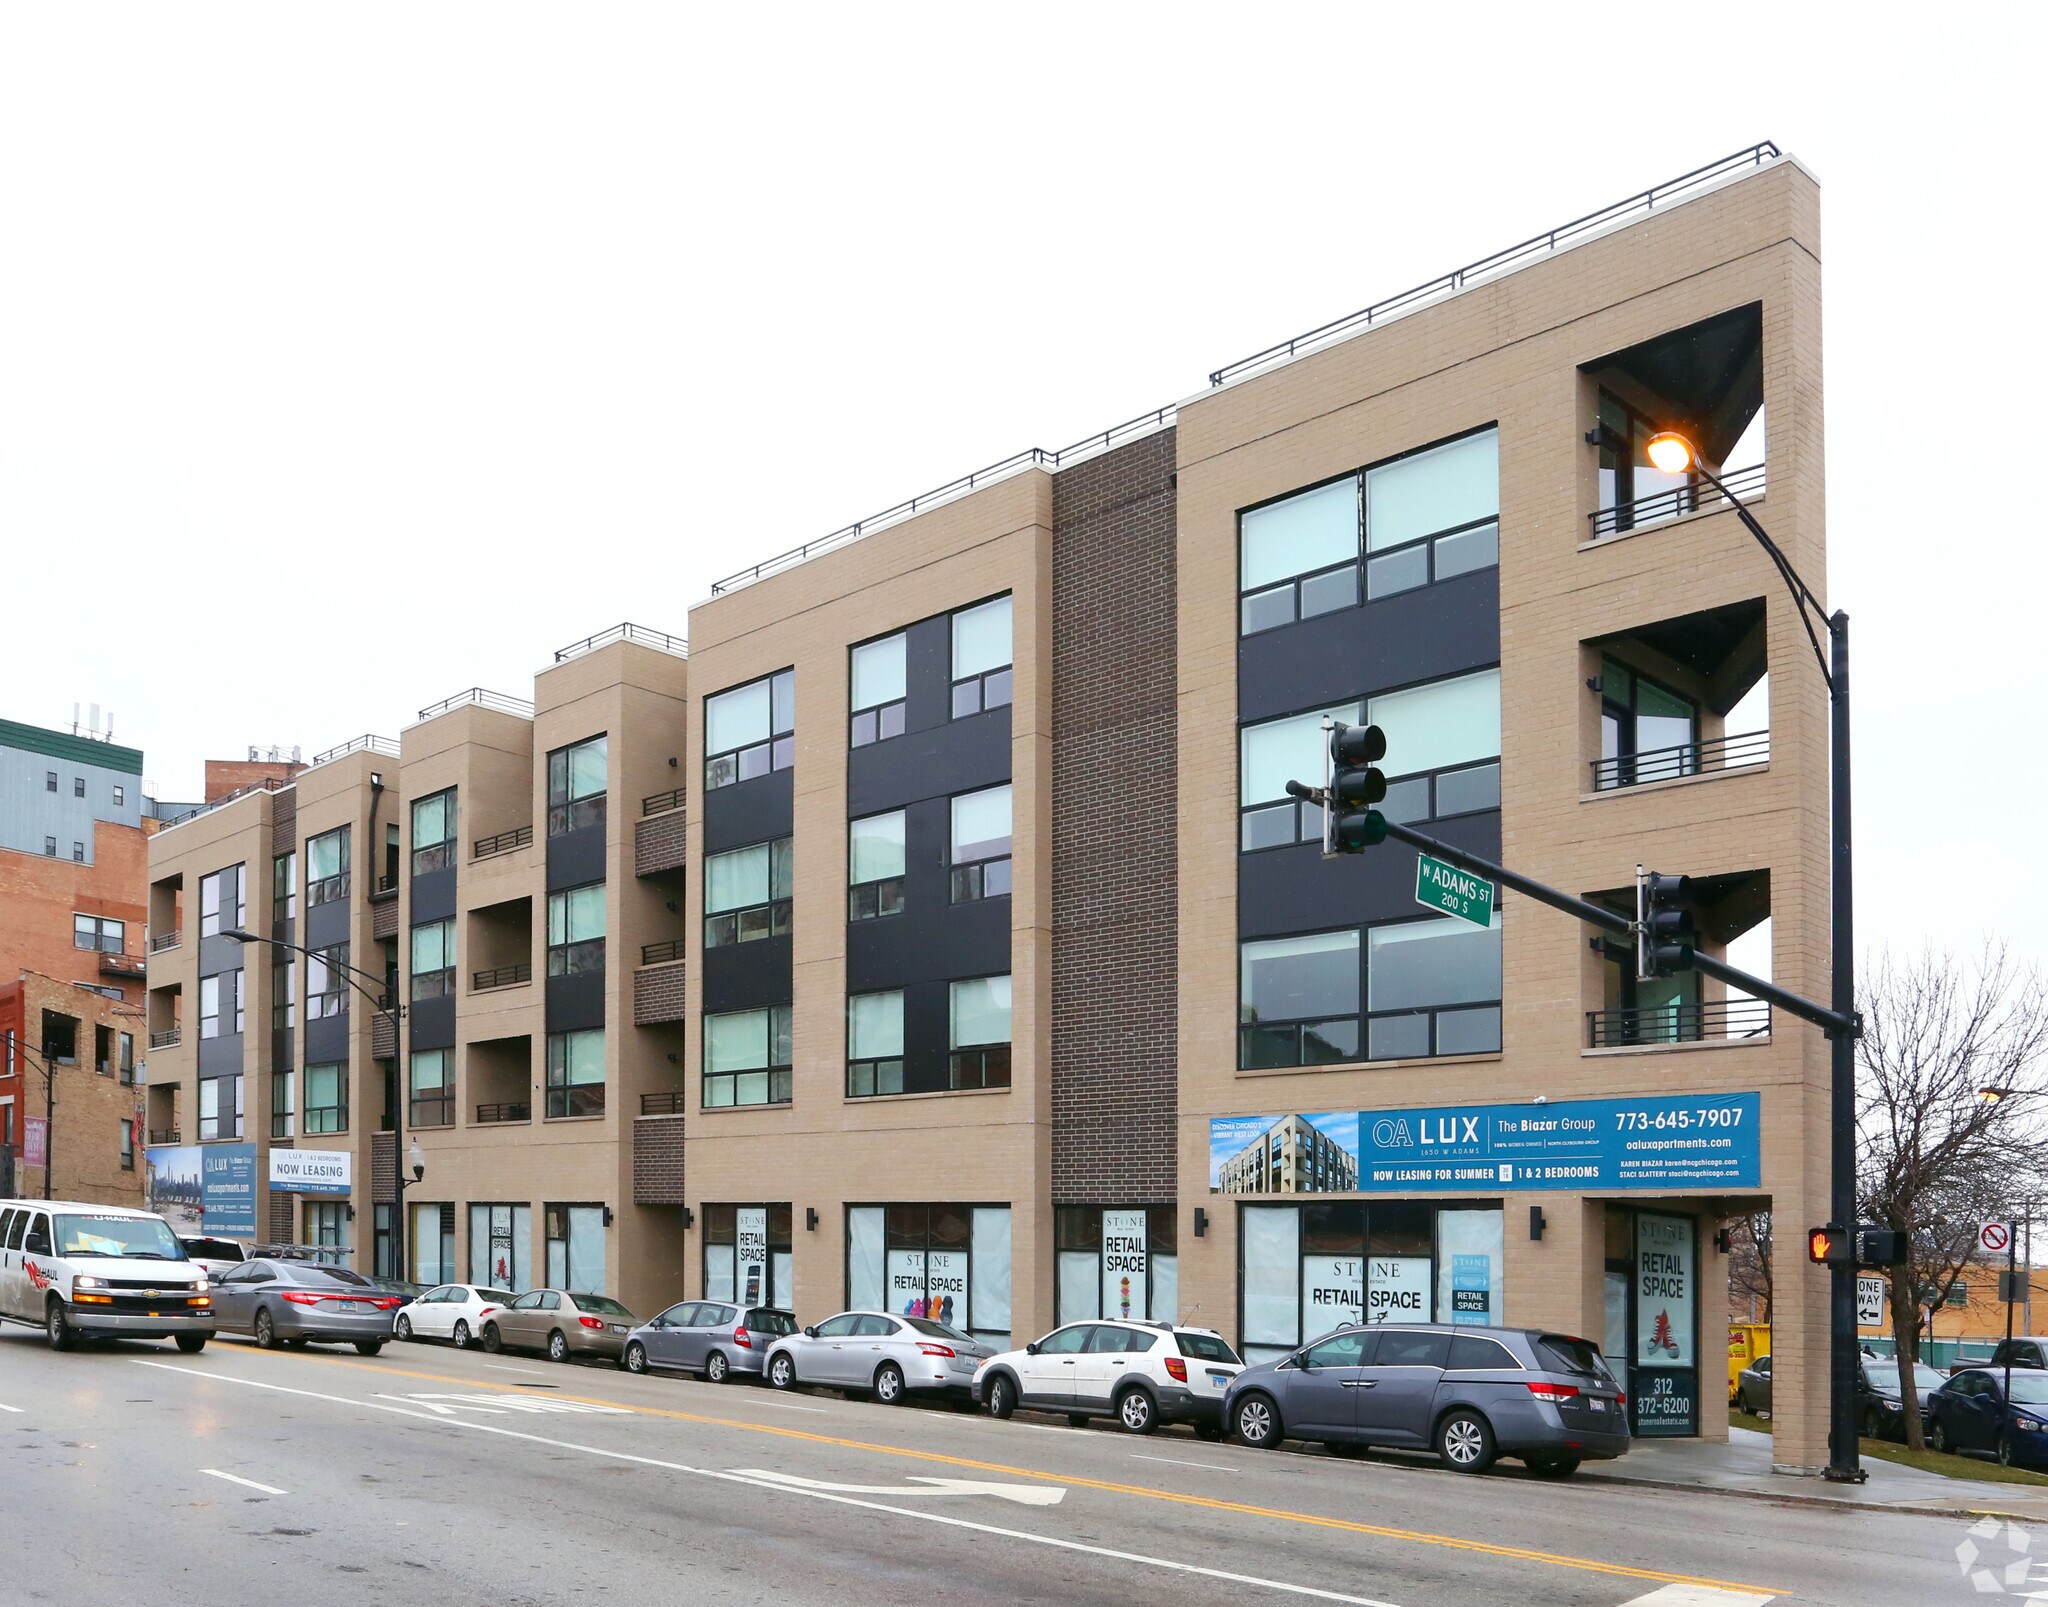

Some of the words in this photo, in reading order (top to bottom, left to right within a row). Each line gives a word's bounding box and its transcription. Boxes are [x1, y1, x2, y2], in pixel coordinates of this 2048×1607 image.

[1423, 864, 1430, 877] W
[1432, 867, 1476, 900] ADAMS
[1479, 889, 1489, 902] ST
[1441, 893, 1458, 909] 200
[1463, 901, 1468, 913] S
[1498, 1121, 1517, 1132] The
[1521, 1119, 1558, 1131] Biazar
[1561, 1118, 1595, 1132] Group
[1616, 1108, 1743, 1131] 773-645-7907
[1212, 1123, 1235, 1131] DISCOVER
[1372, 1119, 1414, 1148] OA
[1421, 1116, 1479, 1144] LUX
[1626, 1138, 1731, 1151] oaluxapartments.com
[215, 1157, 228, 1170] LUX
[277, 1163, 299, 1175] NOW
[303, 1165, 343, 1177] LEASING
[1664, 1159, 1738, 1167] karen@ncgchicago.com
[1373, 1171, 1393, 1181] NOW
[1396, 1169, 1432, 1180] LEASING
[1435, 1169, 1452, 1180] FOR
[1455, 1168, 1494, 1180] SUMMER
[1518, 1168, 1522, 1178] 1
[1526, 1168, 1533, 1178] &
[1535, 1168, 1541, 1178] 2
[1545, 1166, 1599, 1178] BEDROOMS
[1638, 1170, 1666, 1178] SLATTERY
[1668, 1169, 1739, 1177] staci@ncgchicago.com
[1107, 1217, 1144, 1226] STONE
[494, 1240, 511, 1249] SPACE
[740, 1232, 765, 1246] RETAIL
[1106, 1237, 1145, 1253] RETAIL
[740, 1248, 765, 1261] SPACE
[1107, 1255, 1144, 1272] SPACE
[1642, 1252, 1684, 1275] RETAIL
[894, 1275, 925, 1290] RETAIL
[930, 1277, 963, 1292] SPACE
[1643, 1276, 1683, 1298] SPACE
[1858, 1281, 1879, 1292] ONE
[1313, 1288, 1364, 1307] RETAIL
[1370, 1290, 1421, 1309] SPACE
[1457, 1292, 1483, 1300] RETAIL
[1858, 1294, 1880, 1305] WAY
[1457, 1302, 1483, 1310] SPACE
[1654, 1378, 1673, 1394] 312
[1638, 1397, 1689, 1414] 372-6200
